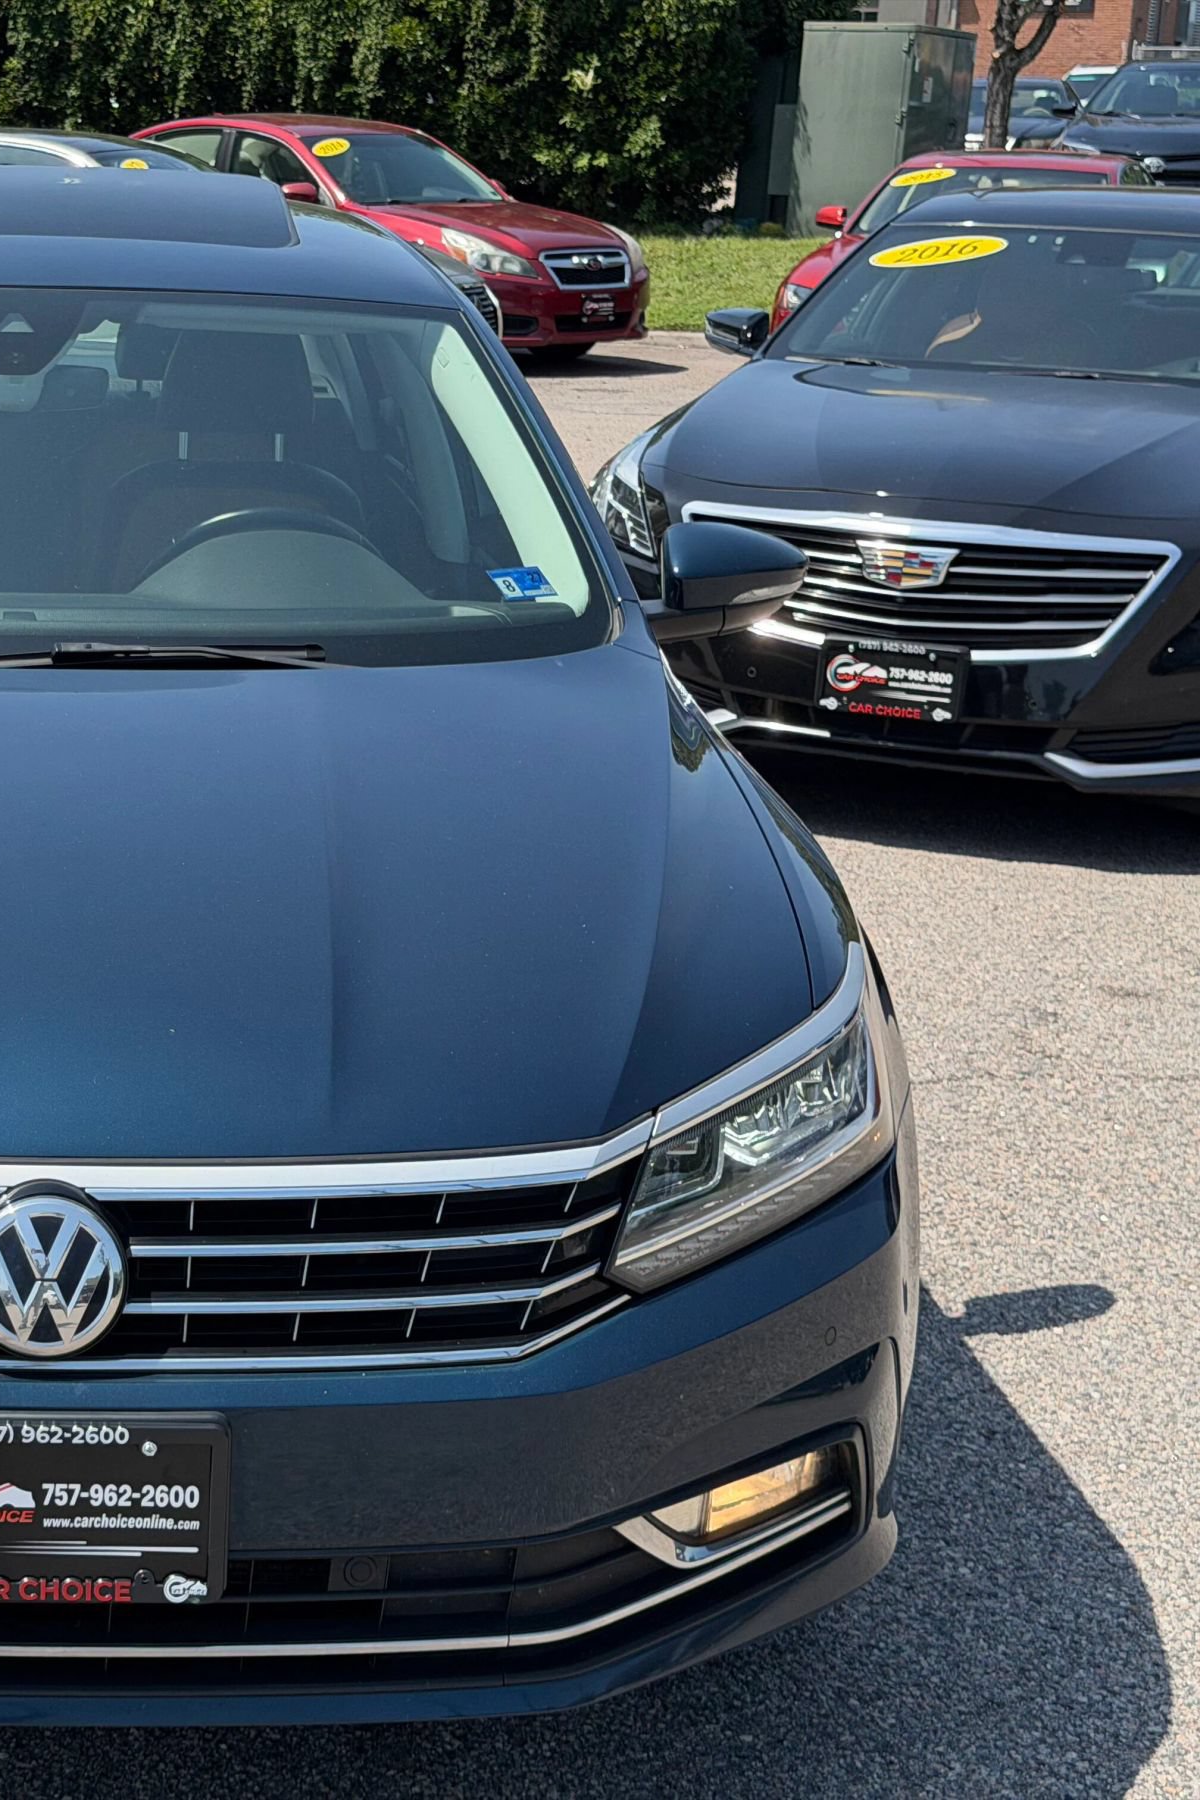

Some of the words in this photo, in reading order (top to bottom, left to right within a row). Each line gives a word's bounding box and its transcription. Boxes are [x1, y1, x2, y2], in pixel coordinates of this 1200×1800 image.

[893, 239, 984, 263] 2016
[502, 579, 516, 593] 8
[848, 702, 873, 714] CAR
[875, 704, 921, 719] CHOICE
[21, 1423, 130, 1445] 962-2600
[42, 1483, 200, 1508] 757-962-2600
[43, 1513, 200, 1530] www.carchoiceonline.com
[18, 1576, 133, 1602] CHOICE
